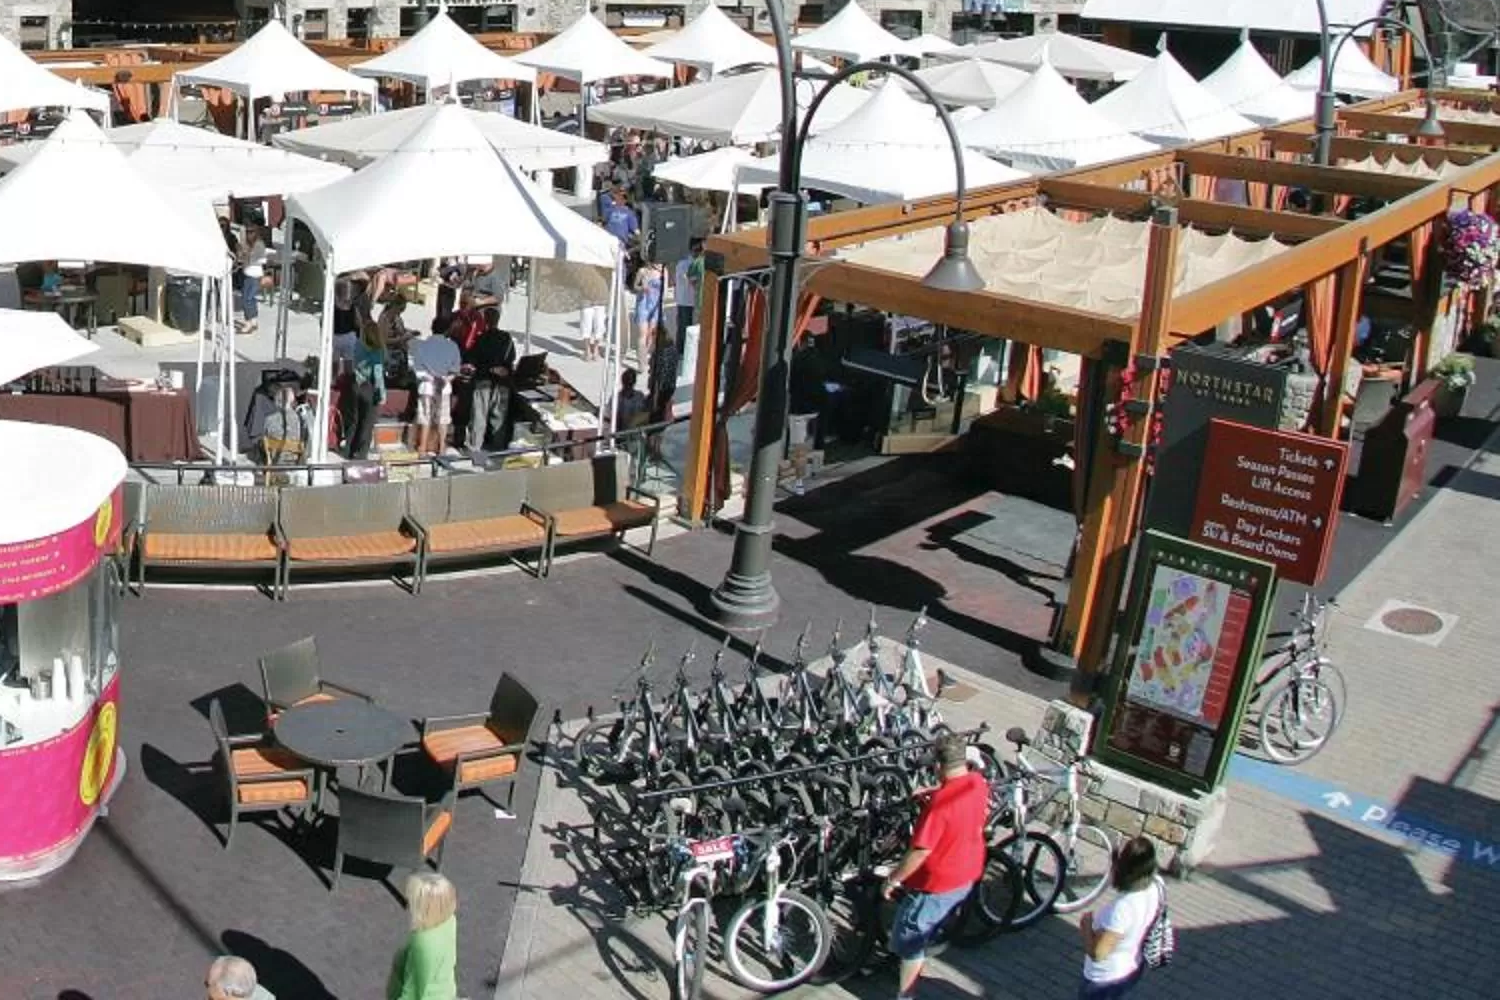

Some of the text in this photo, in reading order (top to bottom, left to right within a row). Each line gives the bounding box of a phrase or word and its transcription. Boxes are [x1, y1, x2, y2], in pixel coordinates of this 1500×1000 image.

[1176, 369, 1274, 404] NORTHSTAR
[1237, 455, 1315, 485] Season Passes
[1279, 447, 1319, 468] Tickets
[1251, 475, 1312, 501] Lift Access
[1221, 493, 1307, 526] Restrooms/ATM
[1219, 530, 1230, 542] &
[1231, 533, 1265, 553] Board
[1265, 543, 1298, 562] Demo
[1235, 517, 1258, 536] Day
[1259, 525, 1302, 545] Lockers
[1361, 804, 1461, 856] Please
[697, 841, 730, 854] SALE
